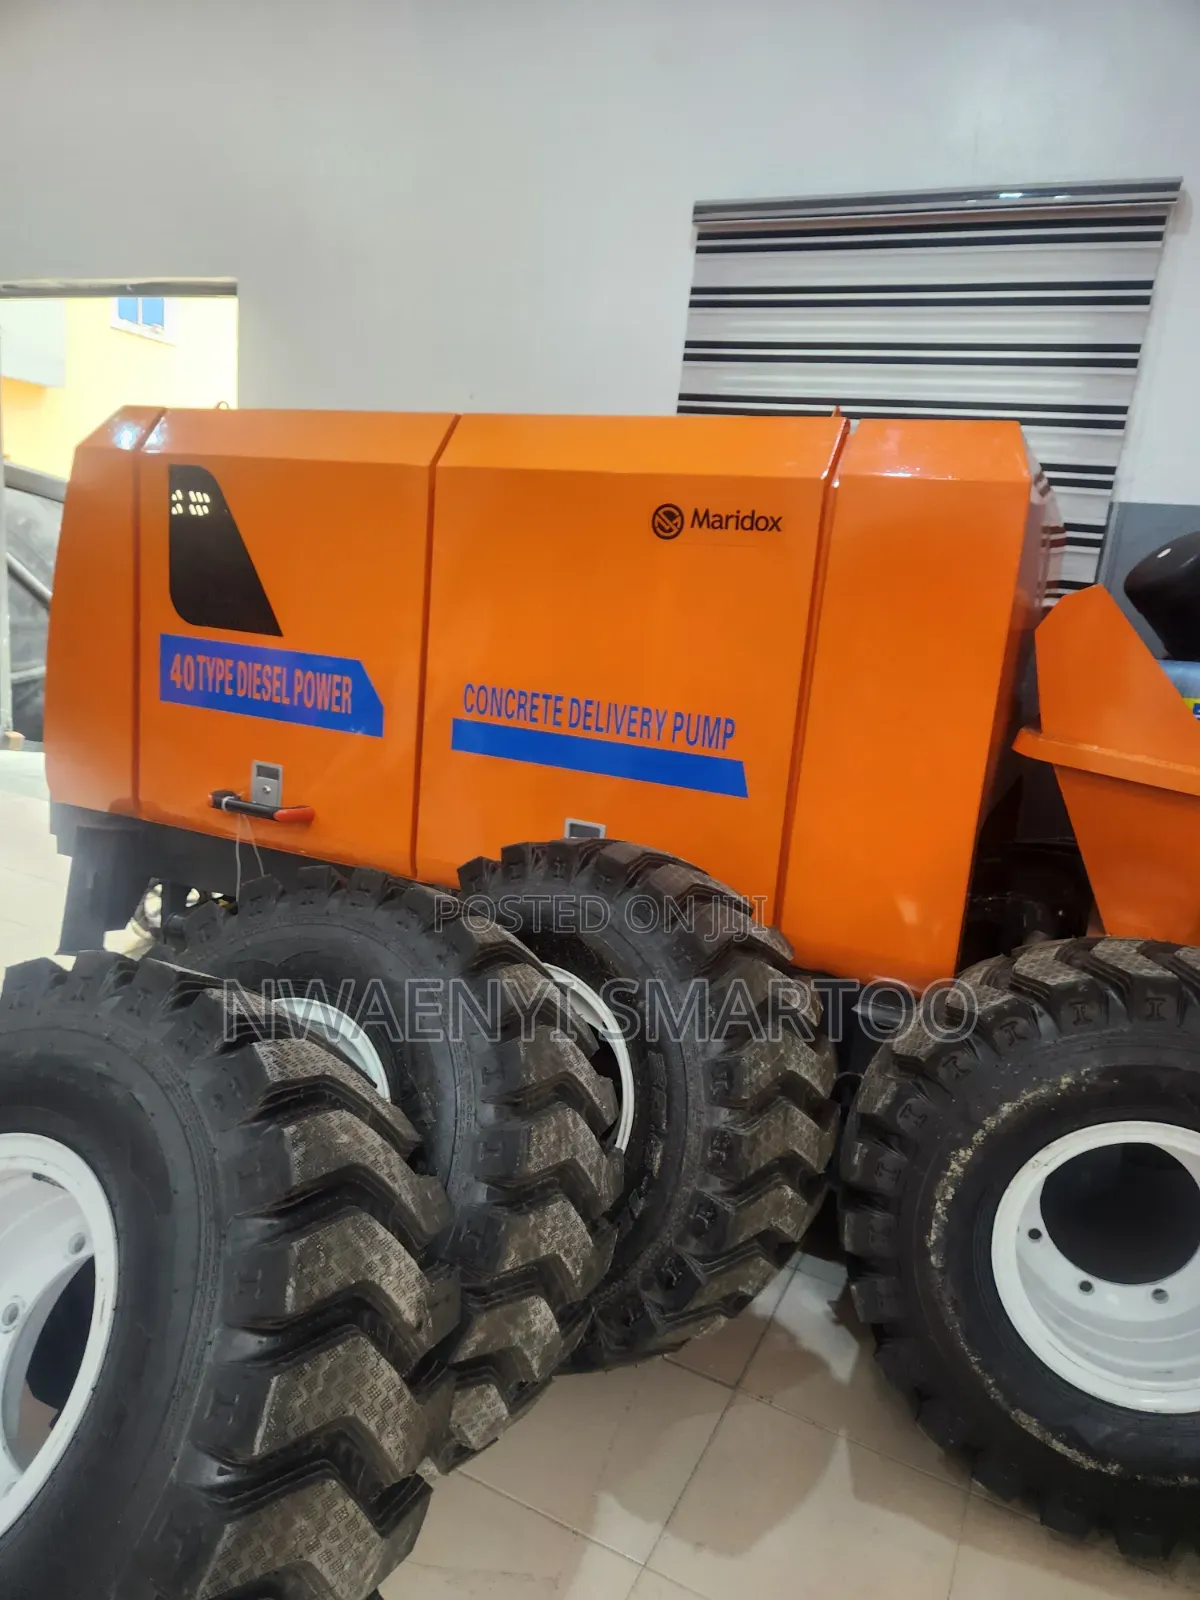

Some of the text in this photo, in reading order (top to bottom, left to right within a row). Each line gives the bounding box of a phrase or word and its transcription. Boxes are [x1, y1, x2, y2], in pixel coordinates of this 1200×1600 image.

[690, 508, 783, 532] Maridox
[237, 661, 291, 706] DIESEL
[293, 670, 353, 714] POWER
[463, 683, 736, 751] CONCRETE DELIVERY PUMP
